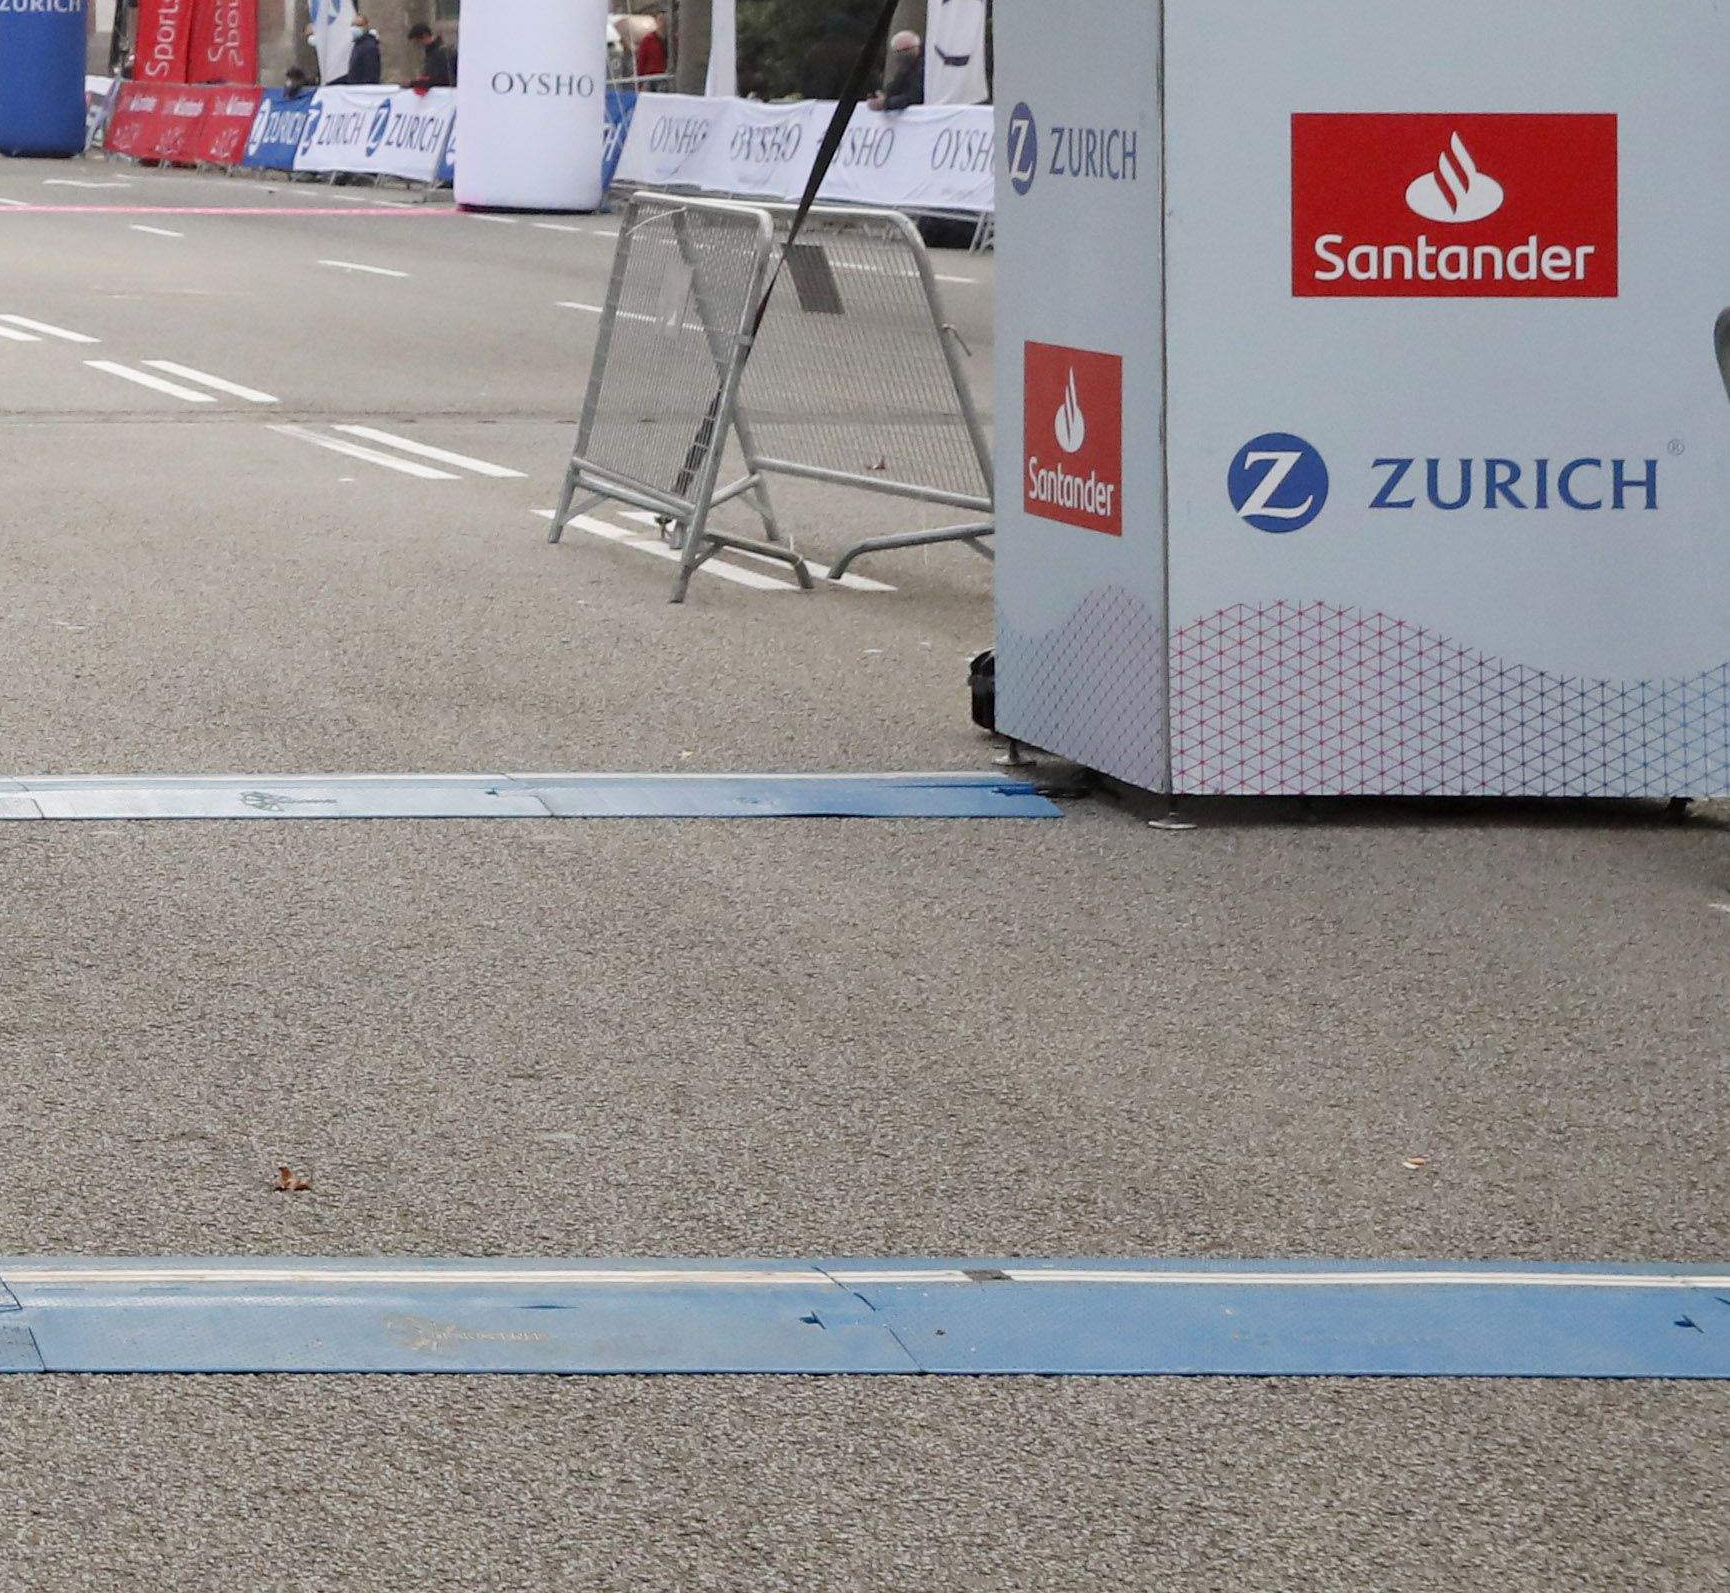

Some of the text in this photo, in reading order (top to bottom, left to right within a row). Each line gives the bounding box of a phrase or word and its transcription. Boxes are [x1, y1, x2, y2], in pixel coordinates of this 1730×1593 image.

[491, 71, 595, 98] OYSHO
[316, 112, 363, 146] ZURICH
[386, 114, 444, 153] ZURICH
[816, 128, 896, 170] SHO
[931, 127, 994, 172] OYSH
[1049, 127, 1137, 181] ZURICH
[1314, 234, 1595, 281] Santander
[1028, 455, 1115, 518] Santander
[1368, 458, 1660, 510] ZURICH
